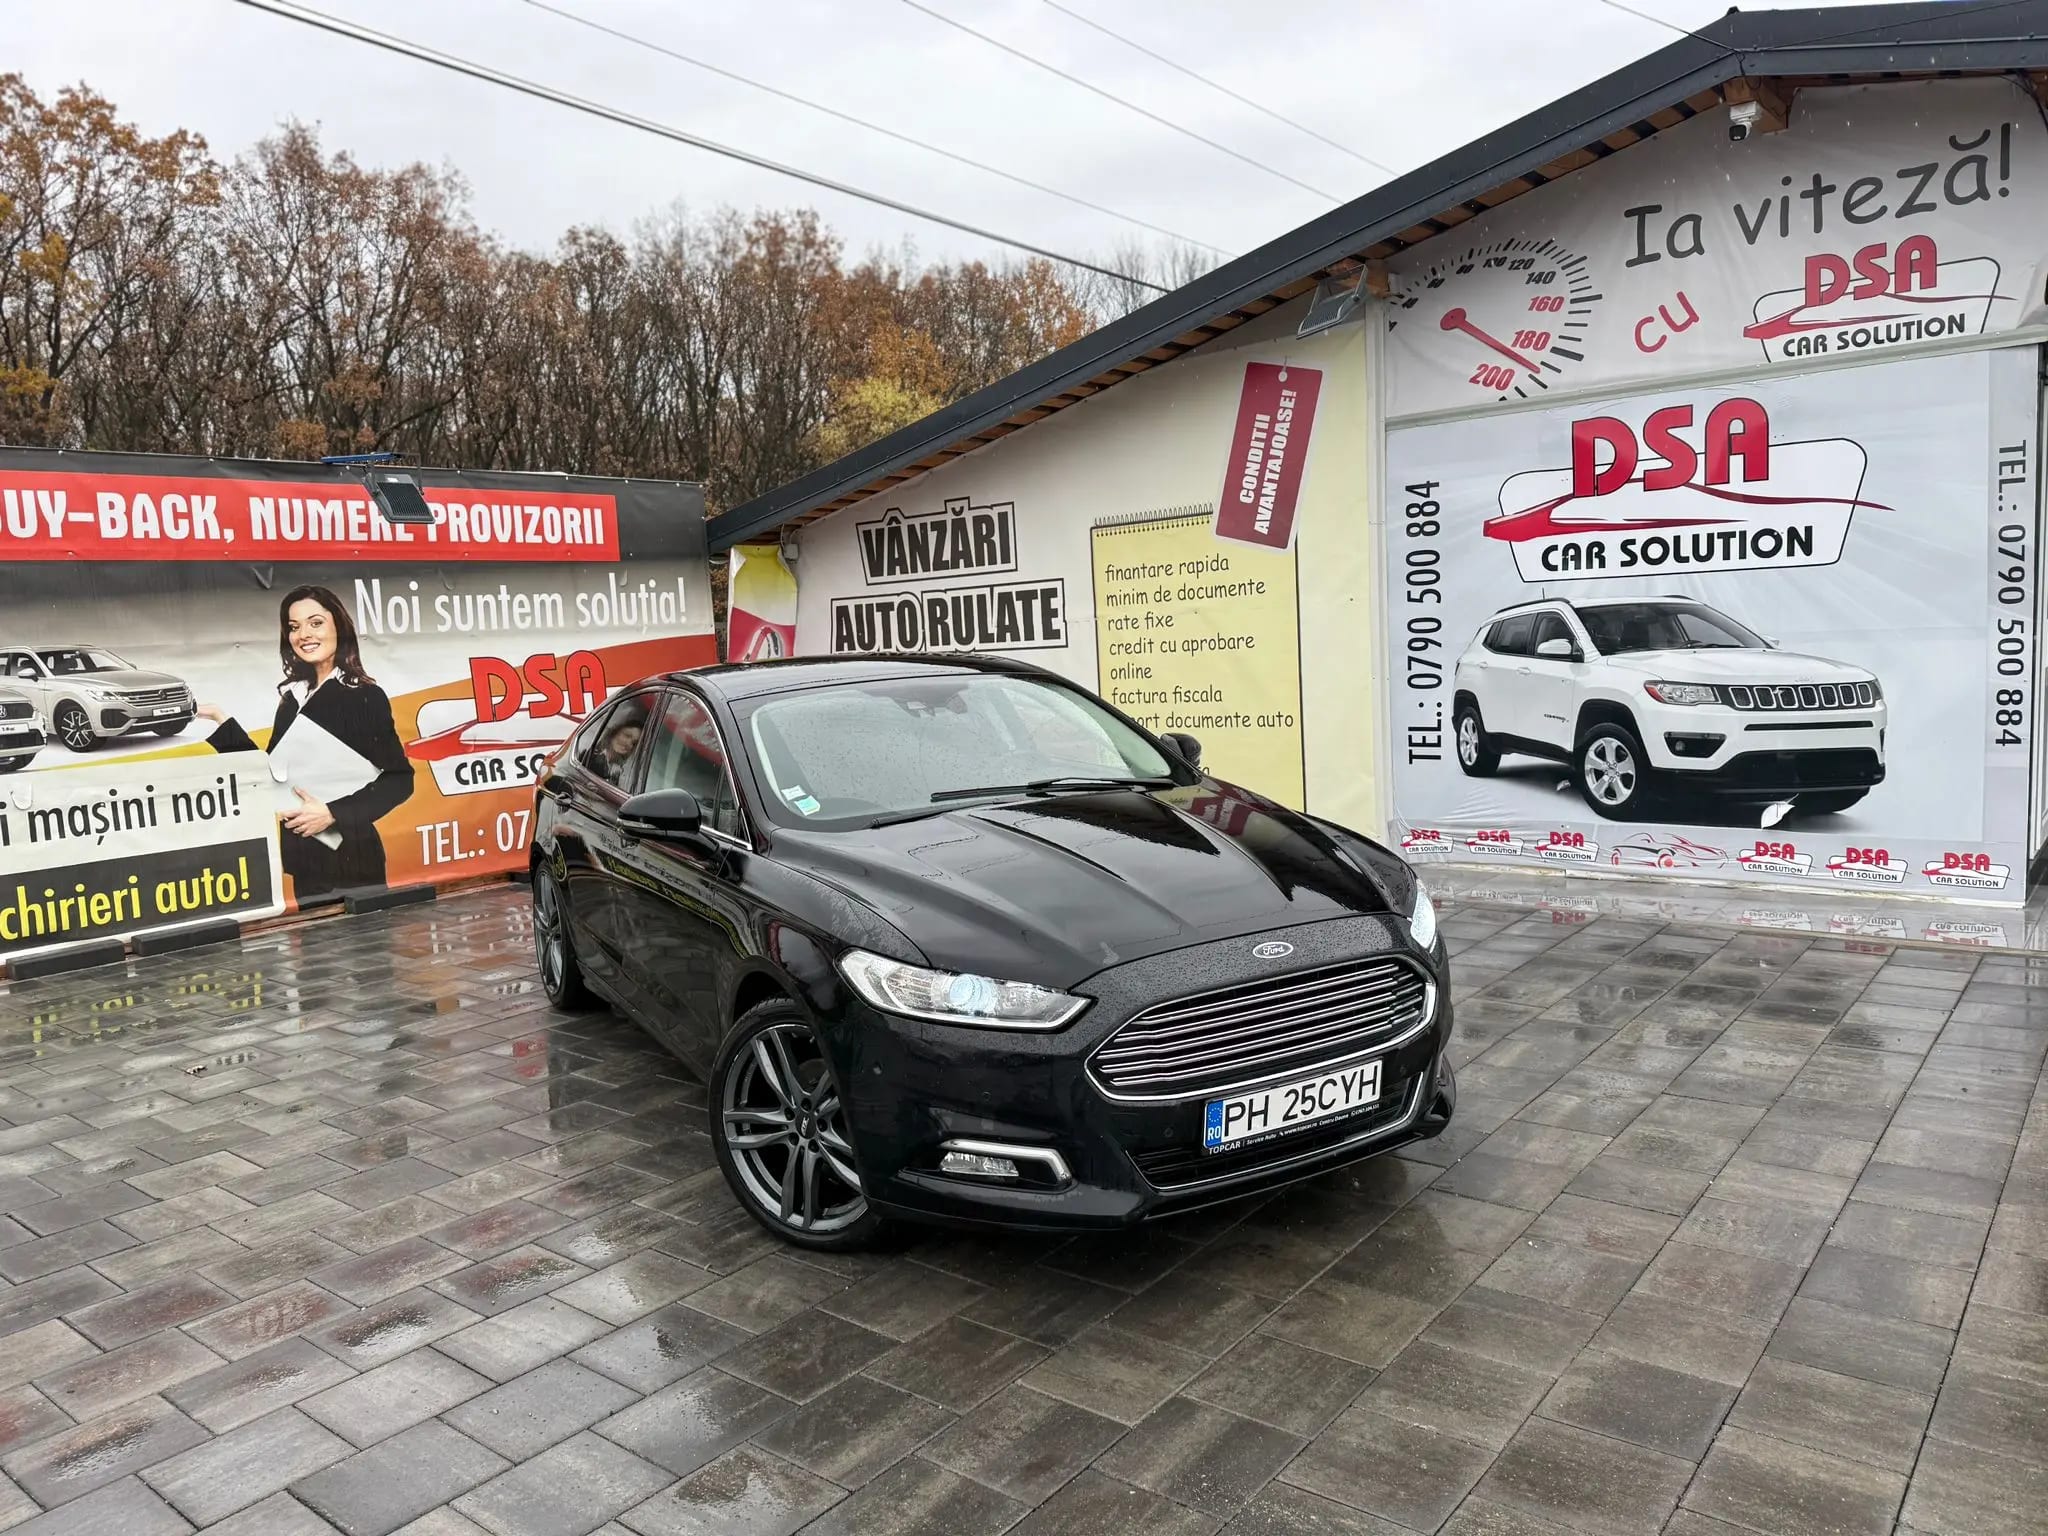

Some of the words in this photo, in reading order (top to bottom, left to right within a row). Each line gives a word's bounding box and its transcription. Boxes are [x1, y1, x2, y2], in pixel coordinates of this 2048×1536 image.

[1624, 203, 1705, 268] Ia
[1733, 123, 2011, 246] viteză!
[1508, 257, 1536, 271] 120
[1525, 270, 1557, 285] 140
[1804, 234, 1938, 309] DSA
[1527, 295, 1565, 313] 160
[1634, 291, 1700, 354] cu
[1510, 329, 1552, 352] 180
[1782, 331, 1829, 357] CAR
[1836, 313, 1966, 345] SOLUTION
[1468, 363, 1516, 391] 200
[1240, 413, 1271, 504] CONDITII
[1254, 389, 1297, 535] AVANTAJOASE!
[1571, 397, 1770, 498] DSA
[0, 489, 235, 543] UY-BACK,
[427, 502, 605, 545] PROVIZORII
[1405, 480, 1441, 537] 884
[862, 506, 1012, 578] VÂNZĂRI
[1541, 540, 1606, 572] CAR
[1619, 525, 1814, 567] SOLUTION
[1105, 563, 1174, 583] finantare
[1179, 553, 1230, 579] rapida
[1405, 549, 1442, 604] 500
[1997, 523, 2026, 605] 0790
[354, 578, 422, 635] Noi
[435, 585, 565, 634] suntem
[1106, 588, 1148, 607] minim
[1153, 585, 1172, 603] de
[1177, 578, 1266, 601] documente
[835, 599, 924, 652] AUTO
[926, 587, 1062, 648] RULATE
[1108, 614, 1140, 631] rate
[1144, 611, 1174, 629] fixe
[1109, 637, 1154, 656] credit
[1160, 639, 1177, 653] cu
[1182, 632, 1255, 657] aprobare
[1406, 617, 1442, 690] 0790
[1996, 618, 2025, 676] 500
[469, 650, 608, 723] DSA
[1110, 662, 1153, 680] online
[1112, 687, 1167, 705] factura
[1172, 684, 1223, 703] fiscala
[1165, 711, 1251, 729] documente
[1256, 711, 1294, 728] auto
[1995, 688, 2024, 747] 884
[454, 757, 507, 786] CAR
[28, 784, 158, 846] mașini
[172, 773, 241, 824] noi!
[416, 820, 486, 866] TEL.:
[1477, 830, 1511, 843] DSA
[1549, 831, 1585, 847] DSA
[1754, 841, 1796, 860] DSA
[1764, 864, 1803, 874] SOLUTION
[1846, 847, 1889, 866] DSA
[1943, 852, 1991, 872] DSA
[1838, 870, 1855, 878] CAR
[1857, 871, 1898, 881] SOLUTION
[1936, 876, 1953, 884] CAR
[1955, 877, 1999, 888] SOLUTION
[0, 875, 141, 941] chirieri
[156, 856, 250, 914] auto!
[1263, 944, 1285, 956] Ford
[1207, 1126, 1221, 1141] RO
[1225, 1094, 1270, 1137] PH
[1282, 1064, 1378, 1122] 25CYH
[1208, 1141, 1241, 1155] TOPCAR
